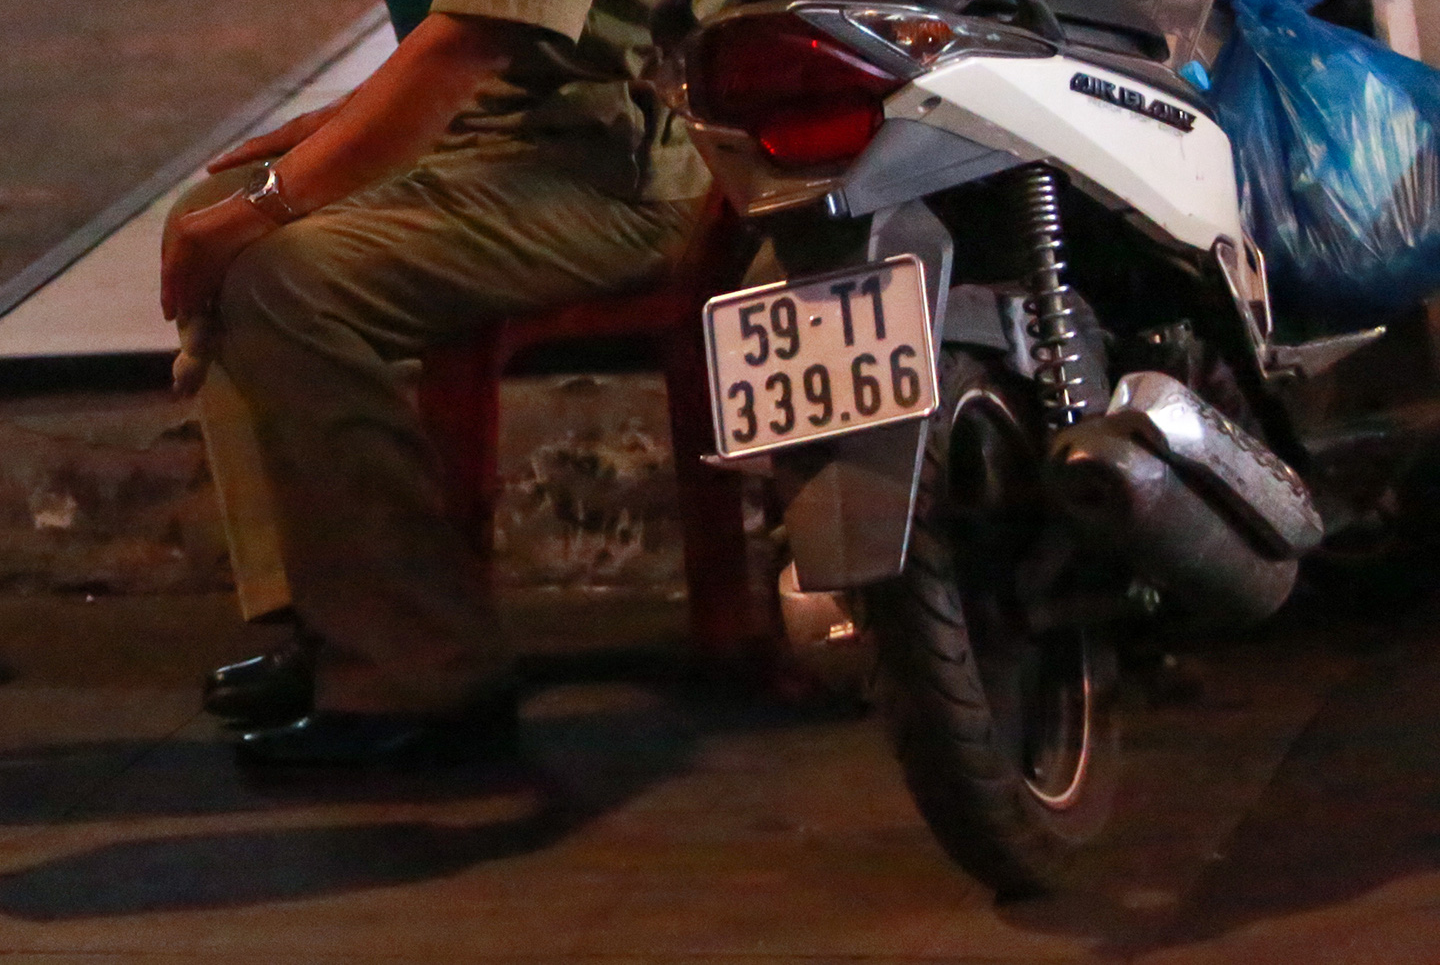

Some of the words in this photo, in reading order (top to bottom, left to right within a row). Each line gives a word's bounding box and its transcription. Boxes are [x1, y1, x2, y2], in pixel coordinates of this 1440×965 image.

[1069, 72, 1117, 106] AIR
[1117, 87, 1197, 133] BLADE
[738, 276, 886, 367] 59-T1
[728, 345, 921, 444] 339.66
